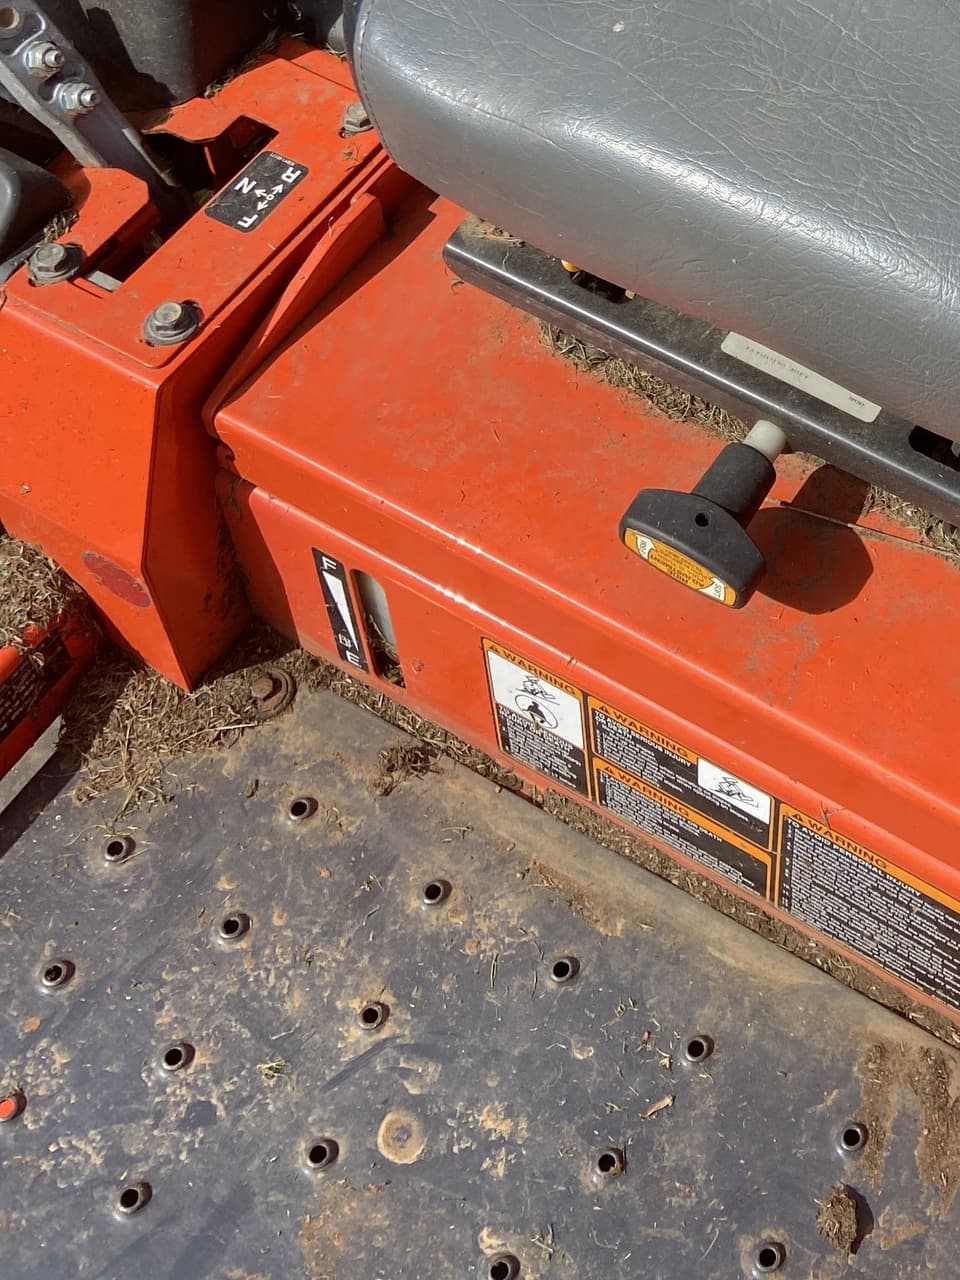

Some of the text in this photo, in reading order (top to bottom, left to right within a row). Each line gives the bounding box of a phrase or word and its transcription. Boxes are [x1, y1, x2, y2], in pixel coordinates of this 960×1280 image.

[281, 167, 302, 183] R
[234, 177, 257, 194] N
[237, 214, 259, 228] F
[322, 556, 337, 570] F
[346, 649, 362, 668] E
[503, 652, 576, 696] WARNING
[613, 711, 688, 758] WARNING
[664, 748, 691, 768] INJURY
[617, 771, 689, 817] WARNING
[808, 819, 887, 869] WARNING
[787, 818, 921, 897] TO AVOID PERSONAL INJURY
